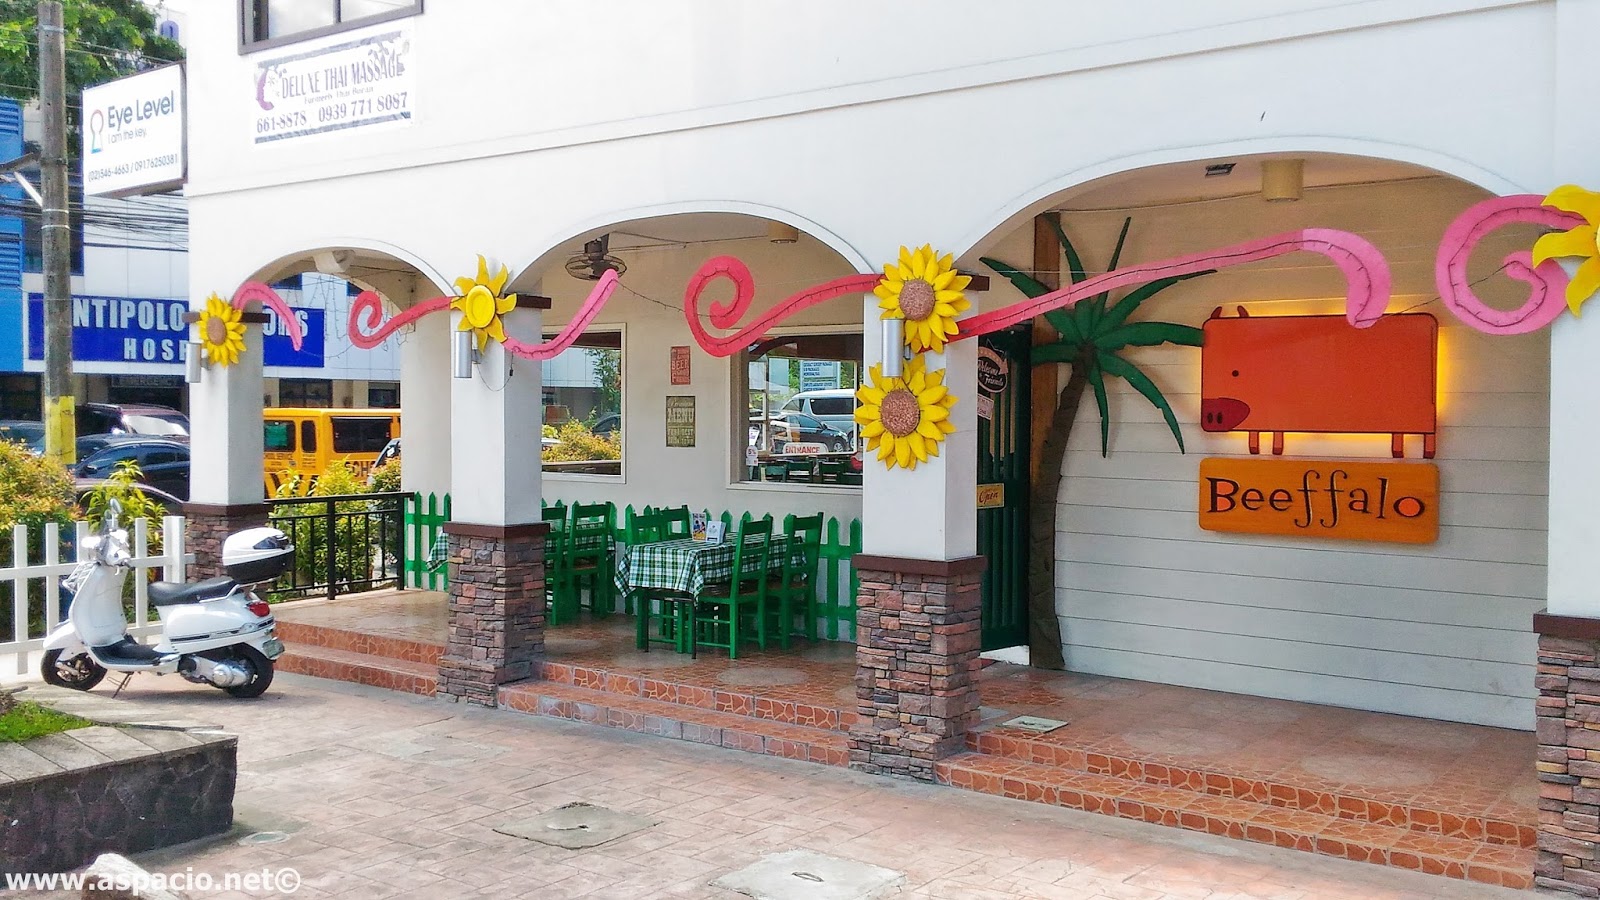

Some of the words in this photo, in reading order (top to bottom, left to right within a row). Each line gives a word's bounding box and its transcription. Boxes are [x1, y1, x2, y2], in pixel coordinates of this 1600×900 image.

[282, 71, 320, 99] DELUXE
[324, 65, 348, 90] THAI
[351, 53, 403, 85] MASSAGE
[108, 105, 133, 131] Eye
[136, 90, 174, 121] Level
[256, 111, 307, 133] 661-8878
[318, 103, 347, 122] 0939
[351, 99, 372, 117] 771
[377, 92, 408, 112] 8087
[111, 133, 122, 143] am
[123, 129, 134, 140] the
[134, 153, 178, 171] 09176250381
[73, 298, 186, 331] NTIPOLO
[1205, 469, 1426, 529] Beeffalo
